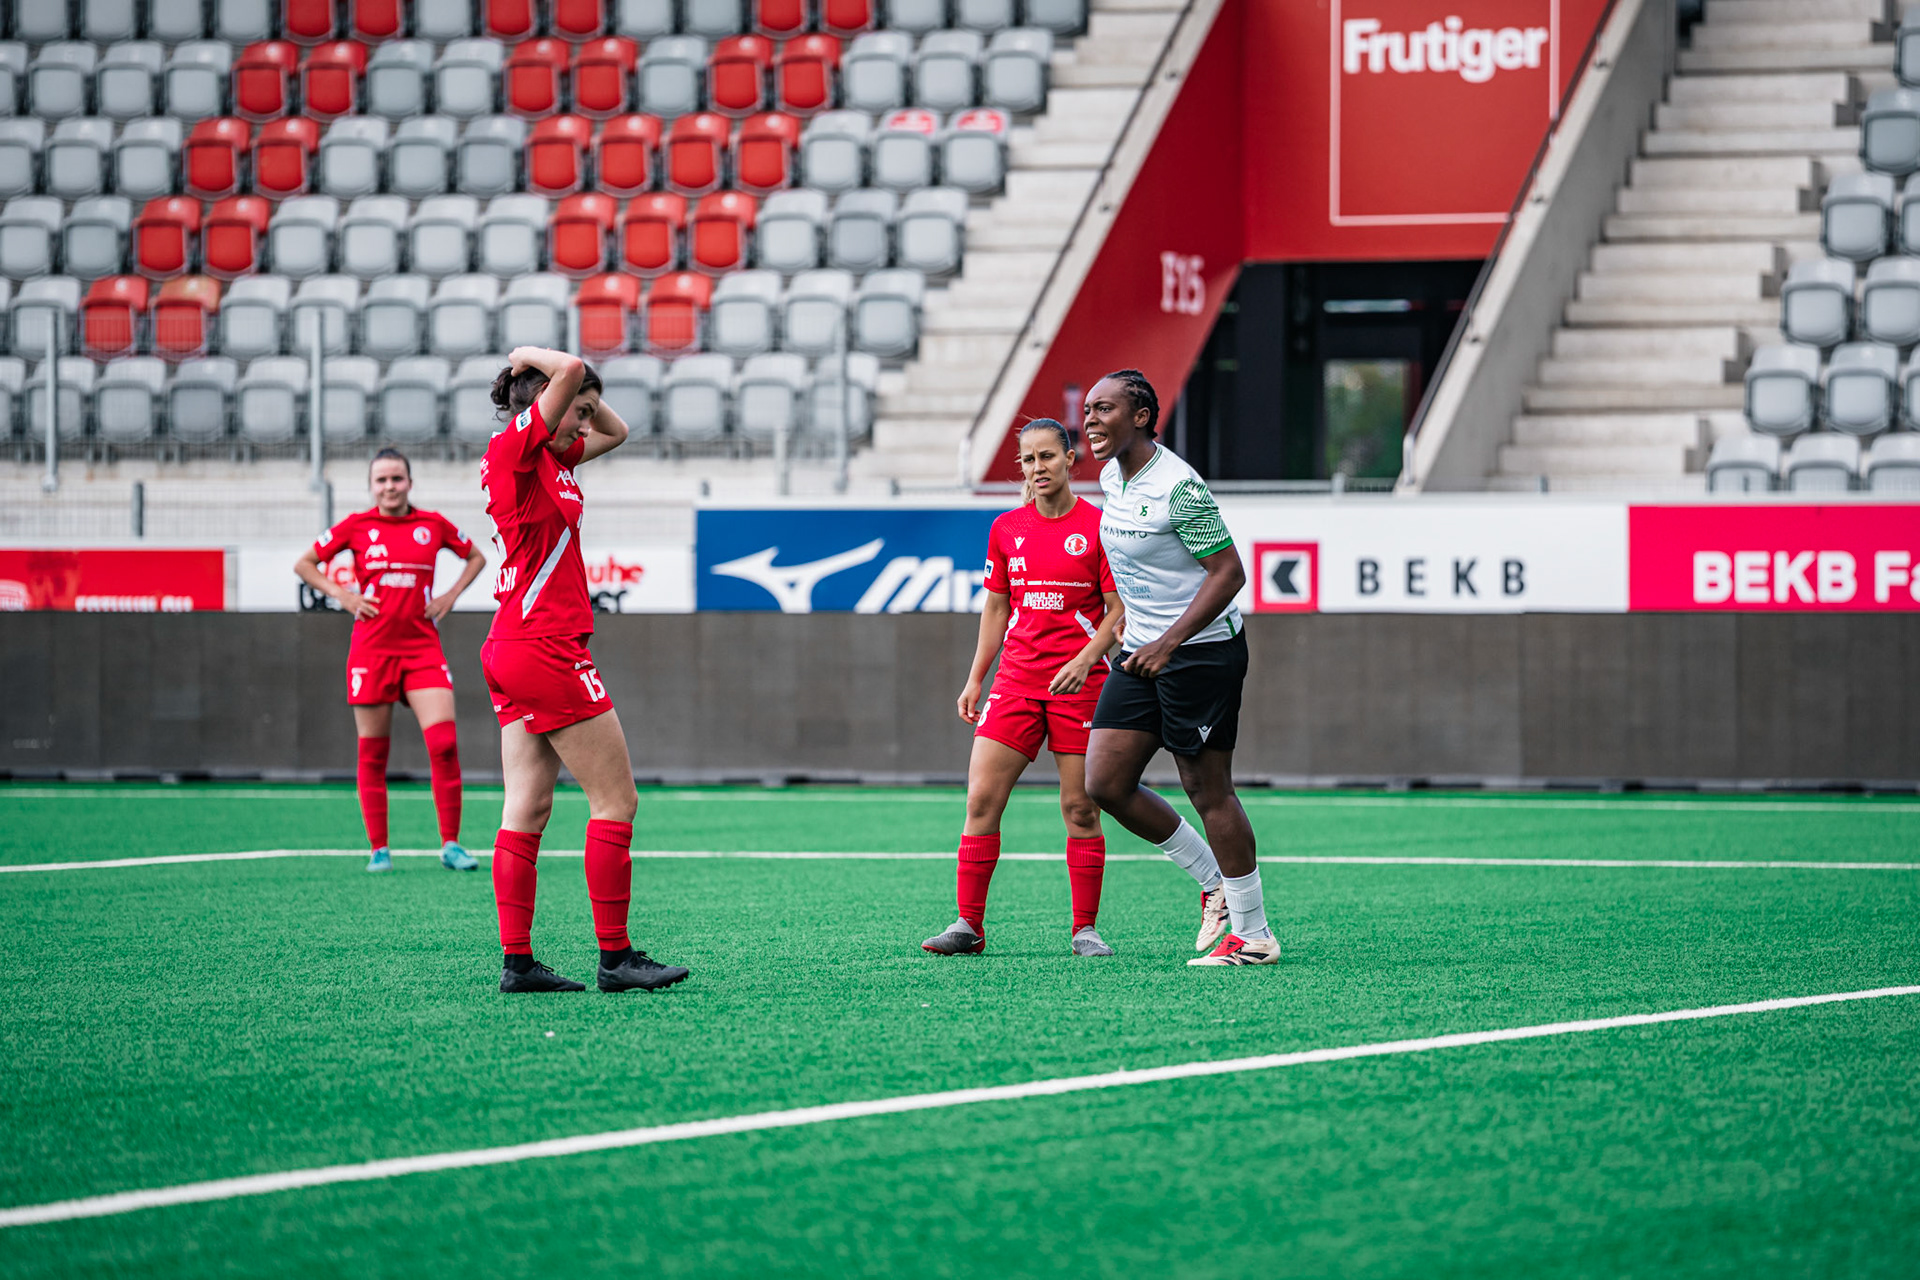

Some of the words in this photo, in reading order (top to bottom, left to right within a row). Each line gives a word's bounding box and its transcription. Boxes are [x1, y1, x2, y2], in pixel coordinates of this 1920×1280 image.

[1343, 15, 1549, 83] Frutiger
[1160, 250, 1206, 315] F15
[556, 470, 575, 486] XA
[1008, 556, 1027, 572] AXA
[1358, 558, 1525, 597] BEKB
[1693, 550, 1857, 604] BEKB
[579, 668, 605, 702] 15
[977, 701, 991, 727] 8
